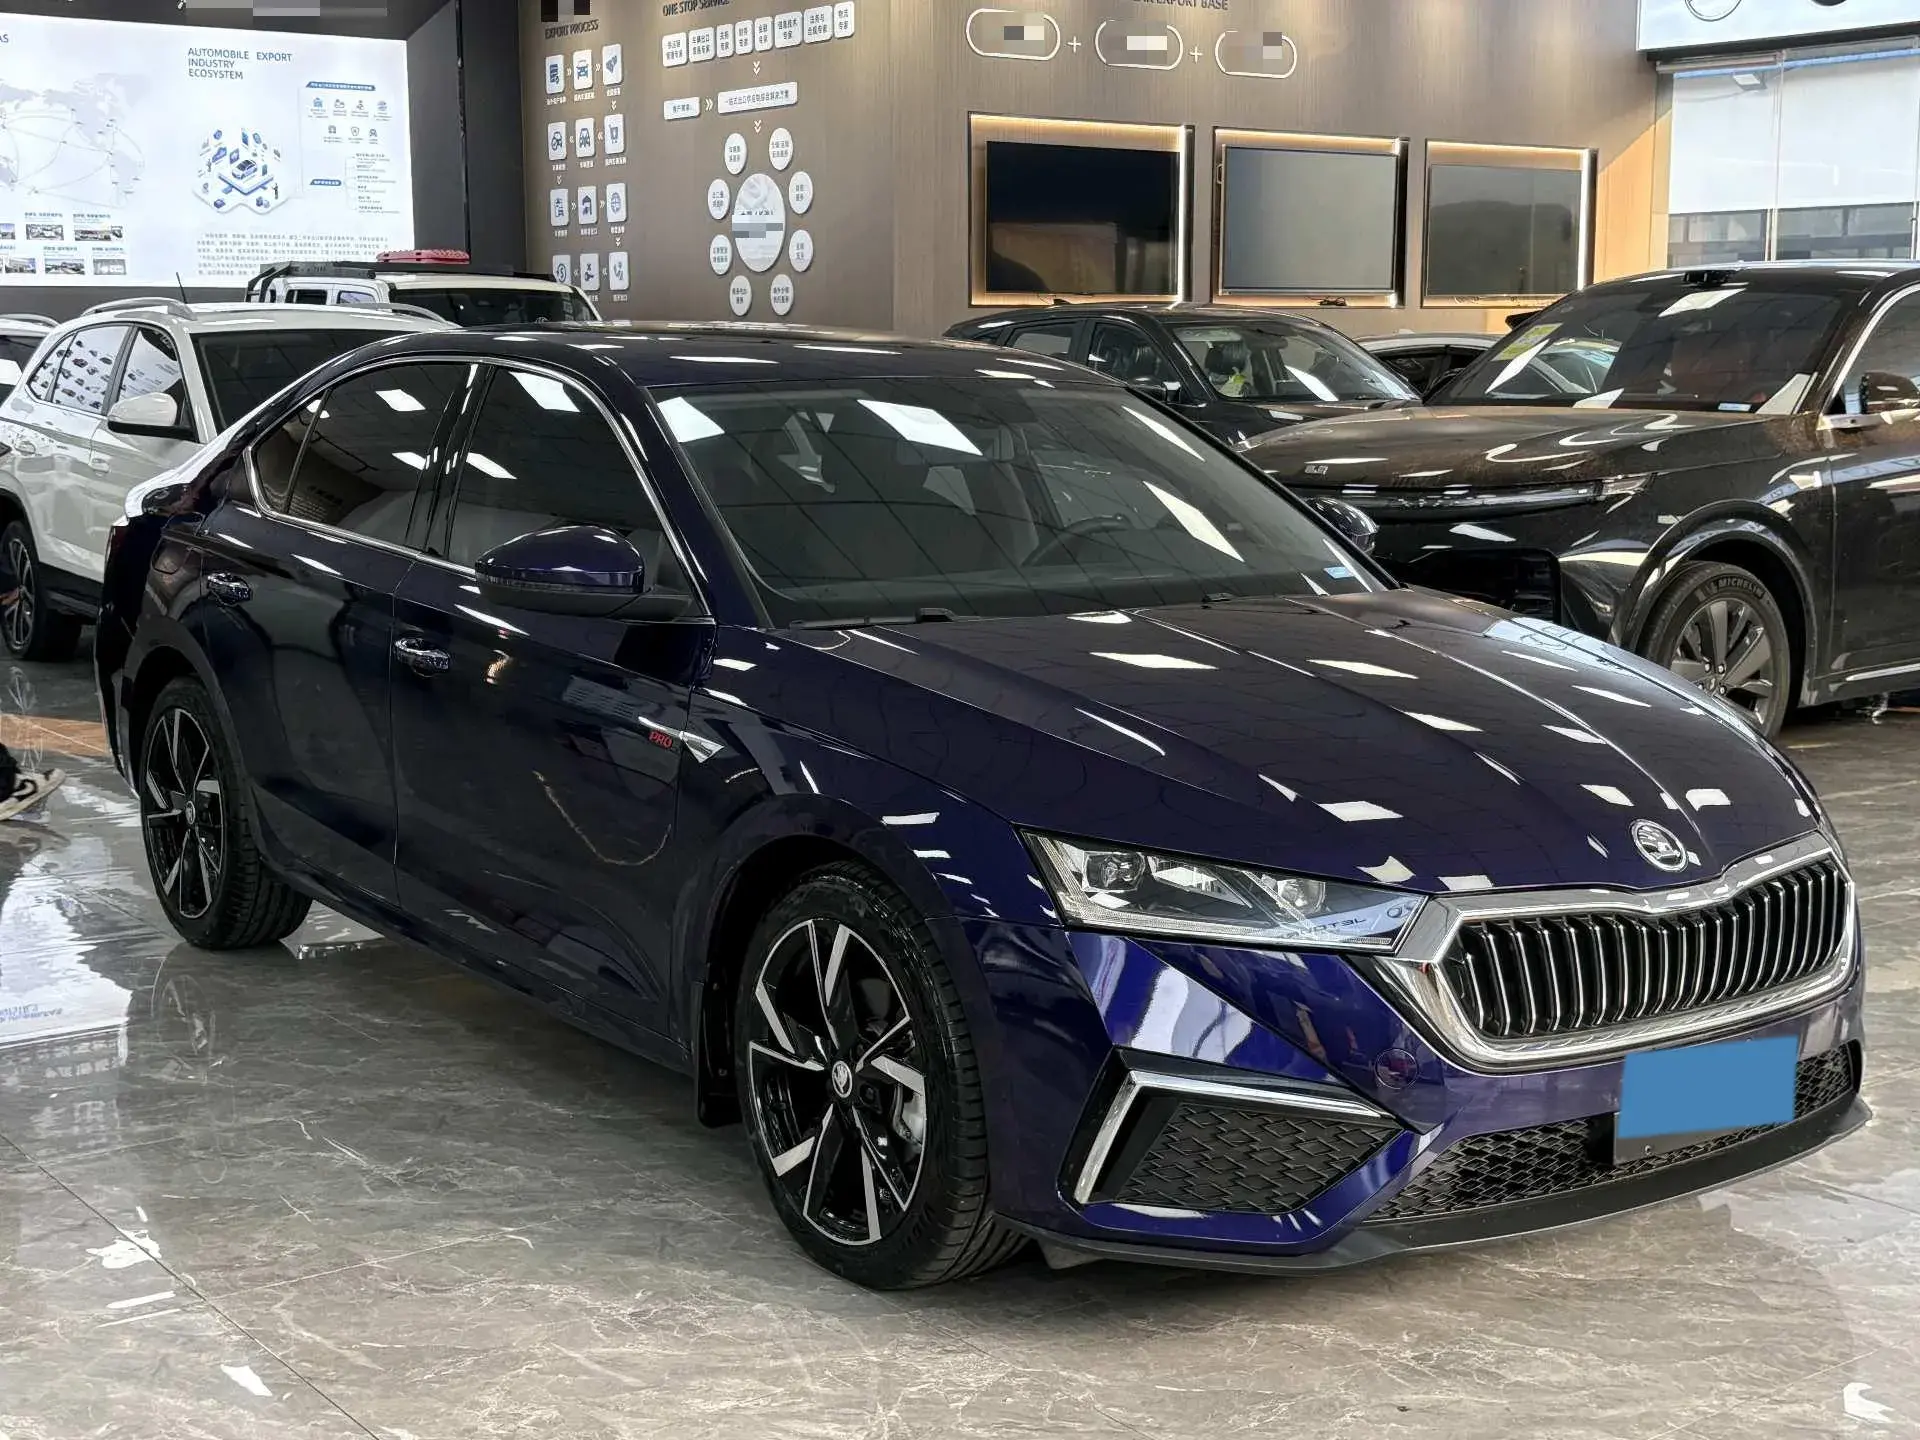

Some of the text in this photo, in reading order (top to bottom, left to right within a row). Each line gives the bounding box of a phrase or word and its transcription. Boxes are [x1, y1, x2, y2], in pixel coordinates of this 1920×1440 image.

[662, 3, 679, 17] ONE
[679, 0, 698, 13] STOP
[545, 19, 599, 39] EXPORT PROCESS
[188, 48, 293, 62] AUTOMOBILE EXPORT
[188, 58, 235, 68] INDUSTRY
[188, 68, 243, 79] ECOSYSTEM
[1718, 577, 1763, 597] MICHELIN
[648, 729, 673, 749] PRO
